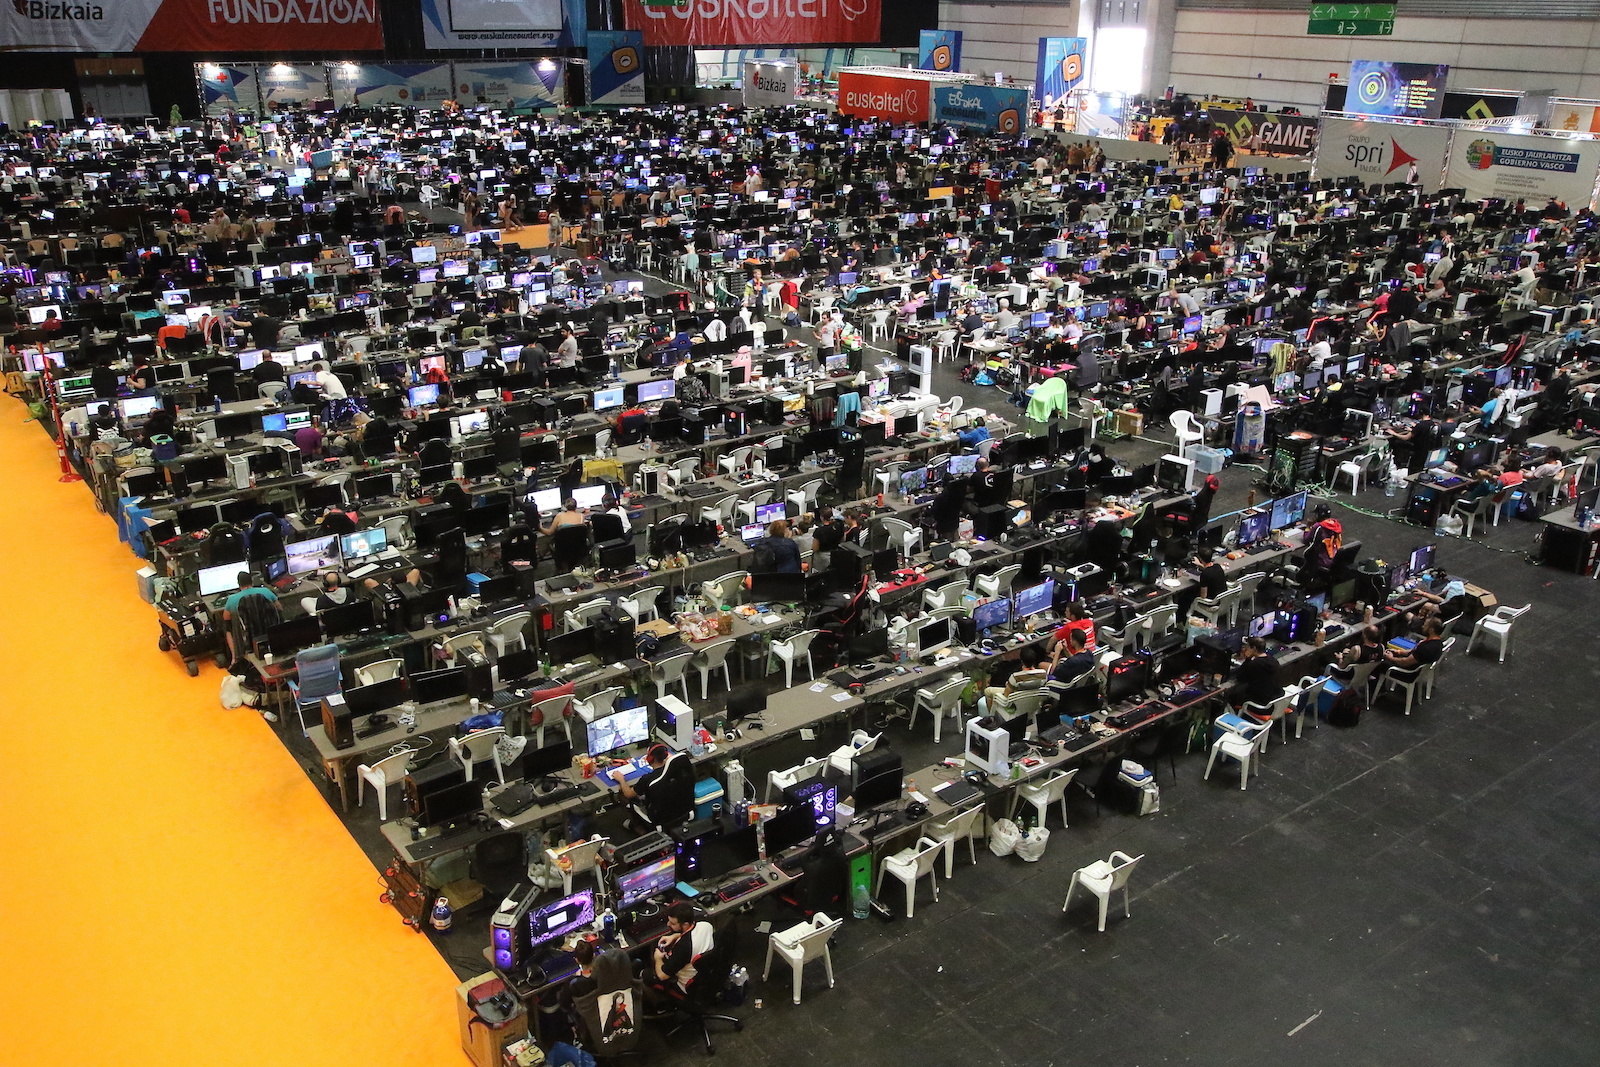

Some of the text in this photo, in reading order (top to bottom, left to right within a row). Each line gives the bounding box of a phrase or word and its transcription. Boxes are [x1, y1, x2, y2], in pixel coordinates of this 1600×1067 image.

[29, 1, 103, 20] Bizkaia
[208, 0, 374, 24] FUNDAZIOA
[758, 77, 786, 93] Bizkaia
[846, 91, 903, 113] euskaltel
[1348, 134, 1371, 143] GRUPO
[1345, 142, 1384, 168] spri
[1501, 148, 1572, 161] EUSKO JAURLARITZA
[1360, 164, 1382, 174] TALDEA
[1499, 157, 1565, 171] GOBIERNO VASCO
